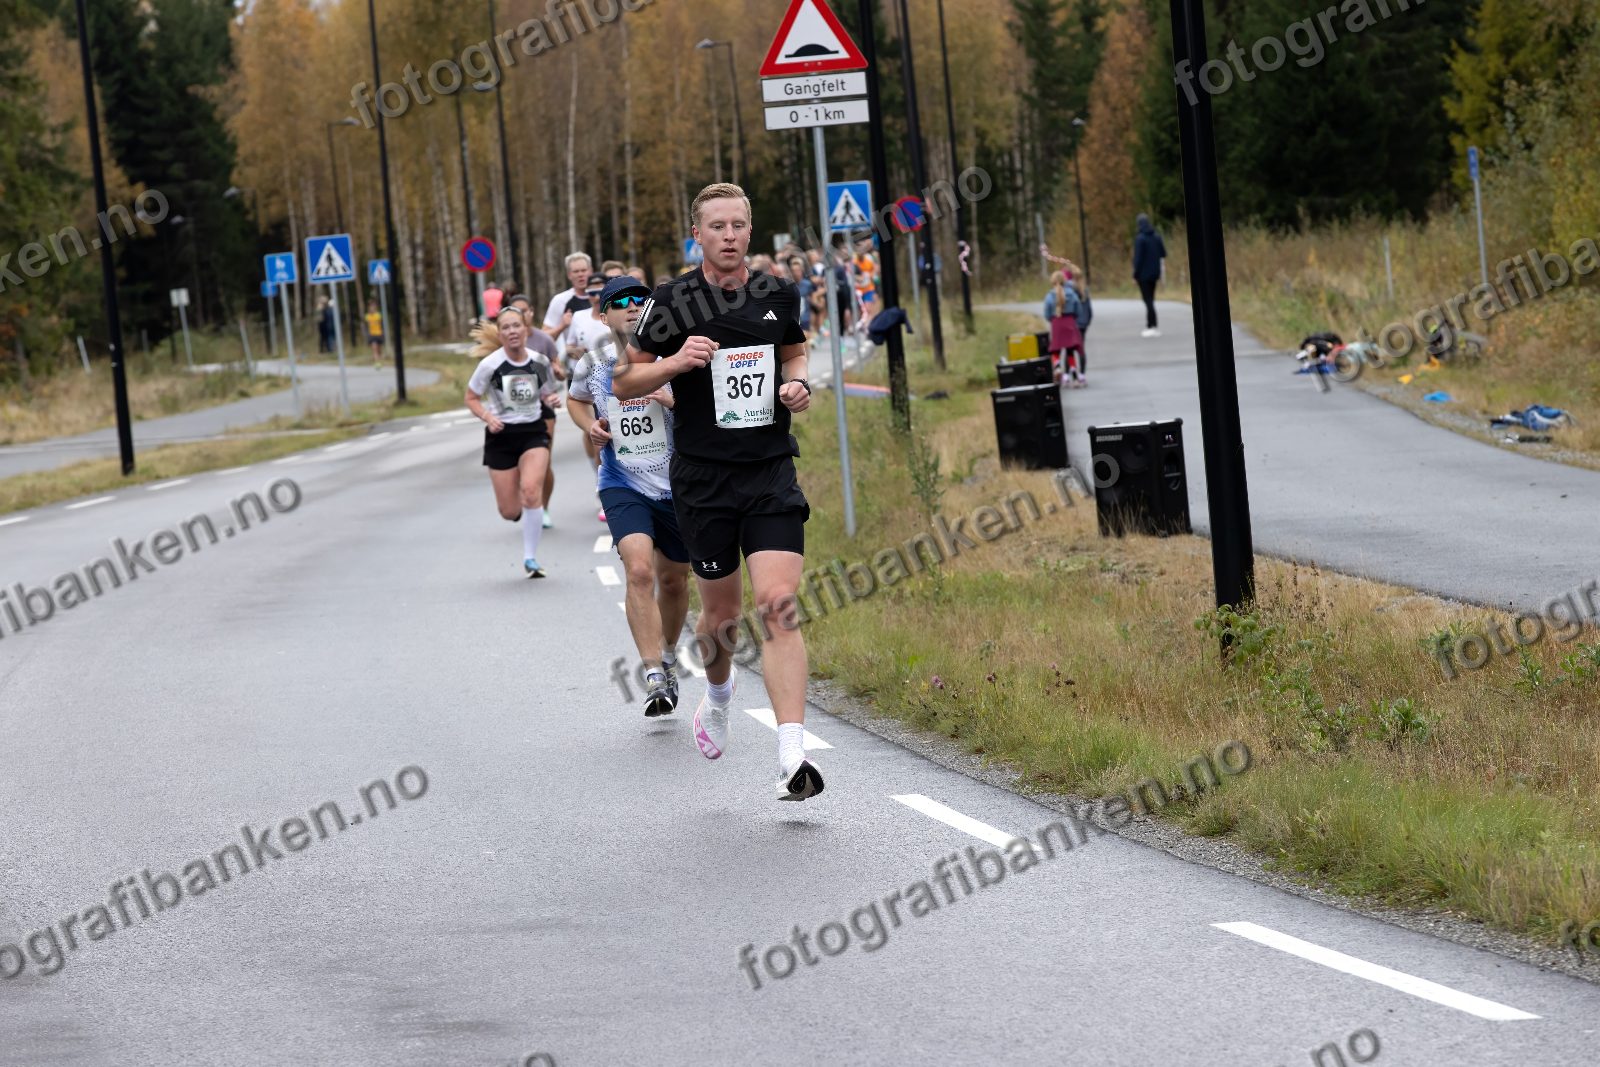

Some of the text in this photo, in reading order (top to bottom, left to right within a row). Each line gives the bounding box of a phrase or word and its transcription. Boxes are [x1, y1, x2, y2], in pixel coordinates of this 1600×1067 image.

[784, 79, 846, 96] Gangfelt
[726, 351, 764, 362] NORGES
[731, 359, 758, 369] LØPET
[727, 373, 765, 400] 367
[619, 399, 651, 408] NORGES
[623, 405, 646, 413] LØPET
[620, 416, 654, 437] 663
